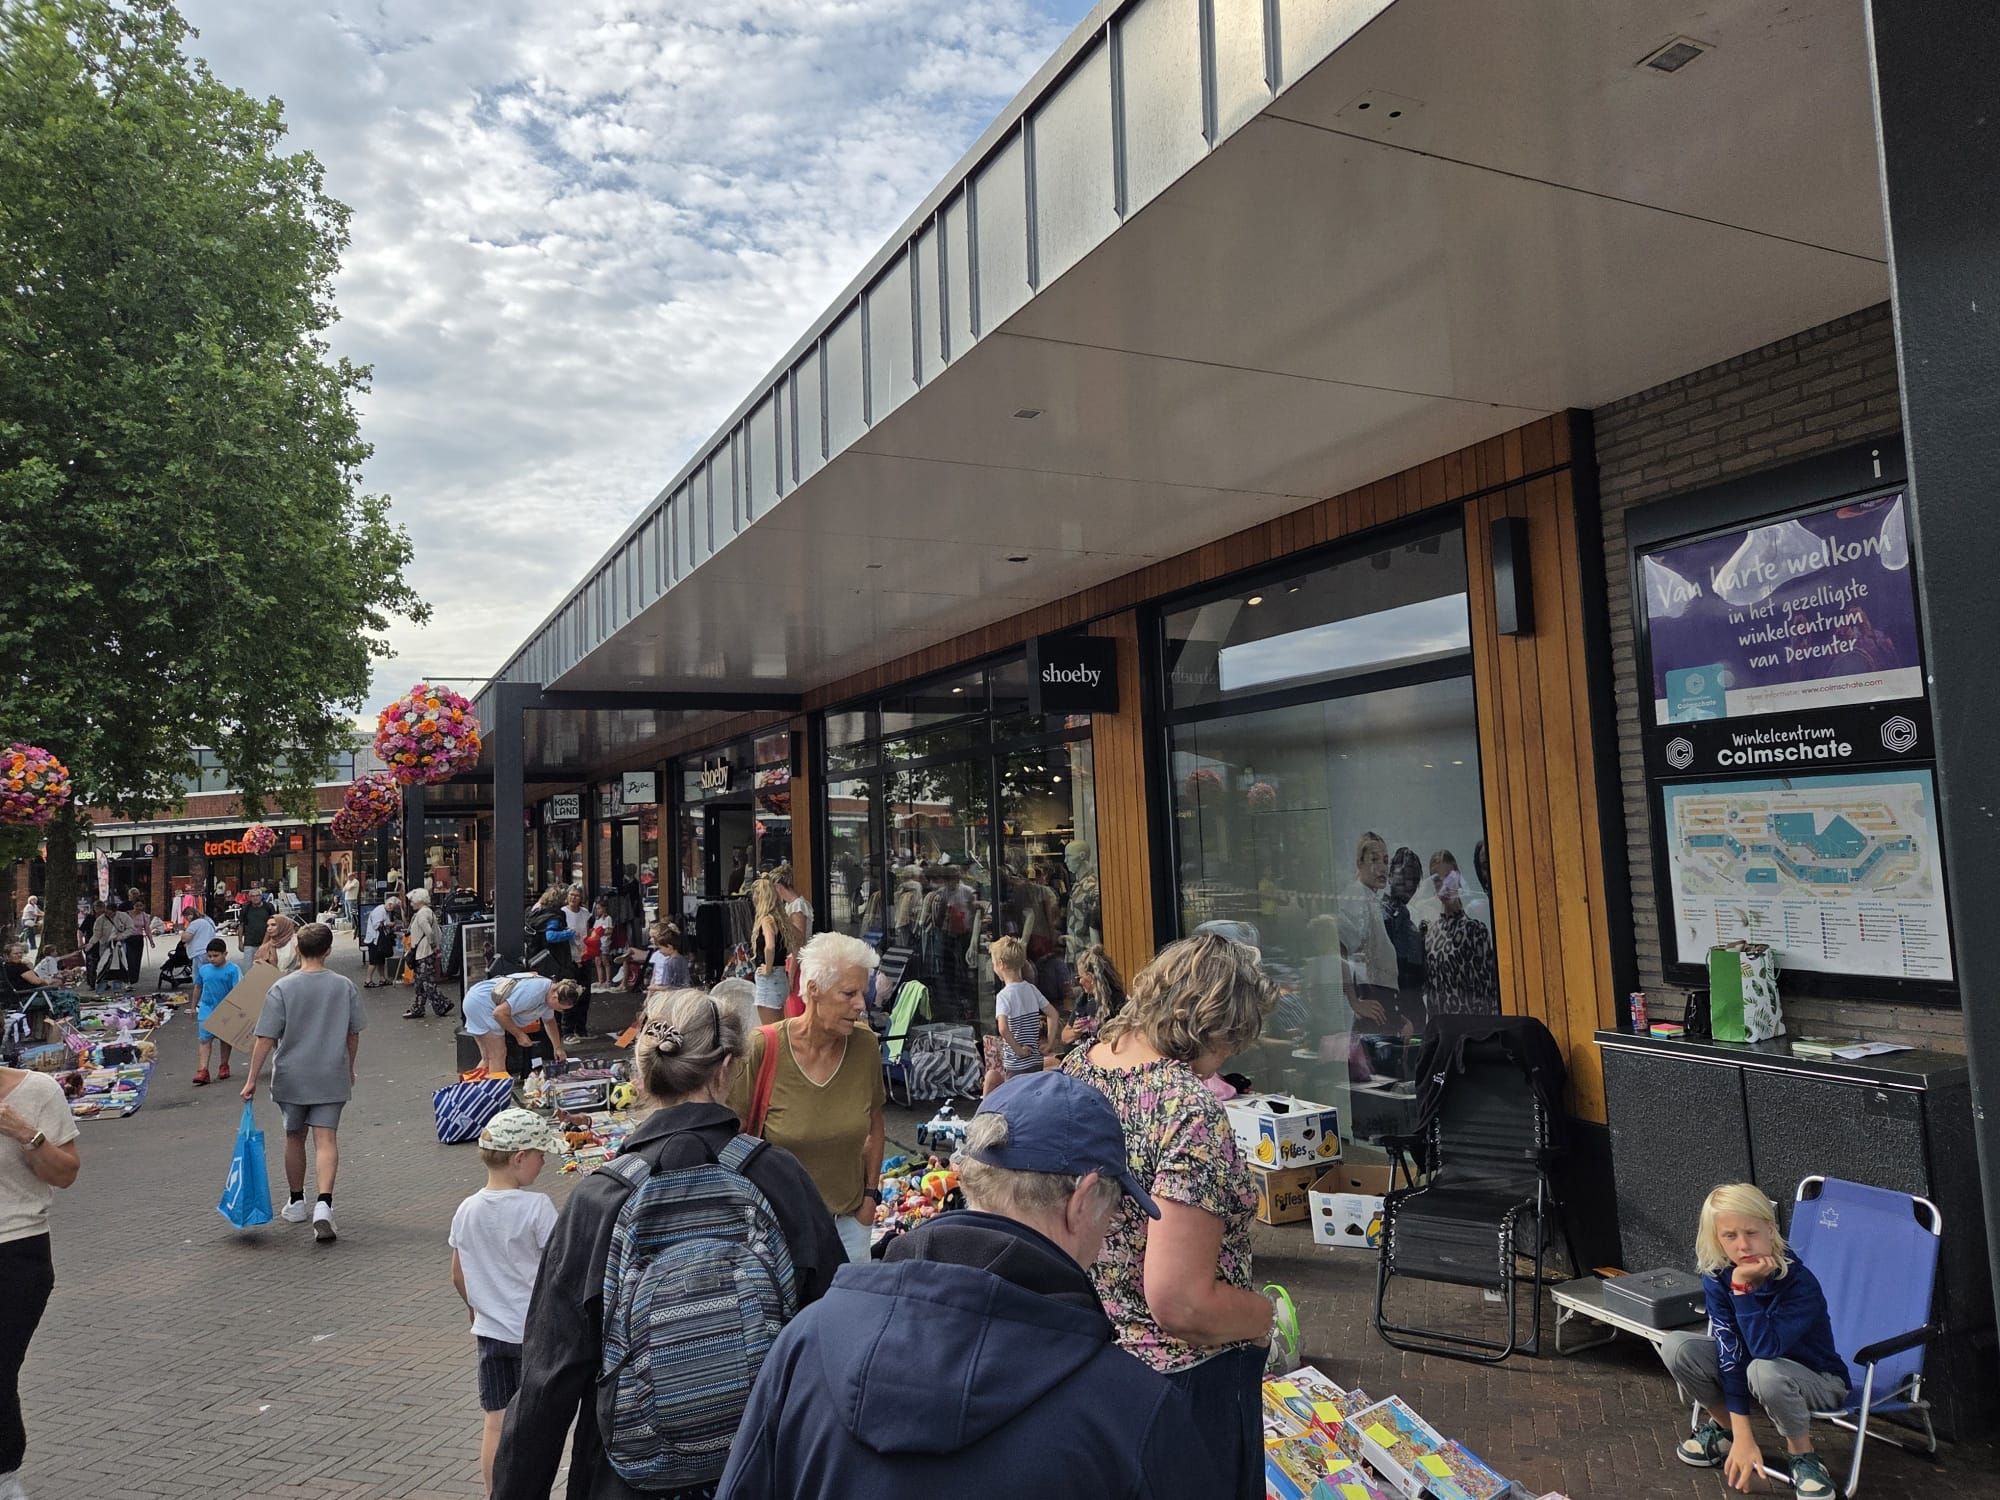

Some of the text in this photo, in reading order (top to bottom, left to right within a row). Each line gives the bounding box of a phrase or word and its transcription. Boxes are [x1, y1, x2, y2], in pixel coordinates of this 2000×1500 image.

[1656, 535, 1892, 608] Van harte welkom
[1728, 578, 1869, 624] in het gezelligste
[1738, 611, 1863, 646] winkelcentrum
[1749, 636, 1857, 668] van Deventer
[1042, 662, 1102, 688] shoeby
[1801, 678, 1883, 695] www.colmschate.com
[1732, 725, 1835, 747] Winkelcentrum
[1717, 740, 1852, 766] Colmschate
[701, 757, 729, 792] shoeby
[554, 797, 578, 807] KAAS
[554, 806, 578, 816] LAND
